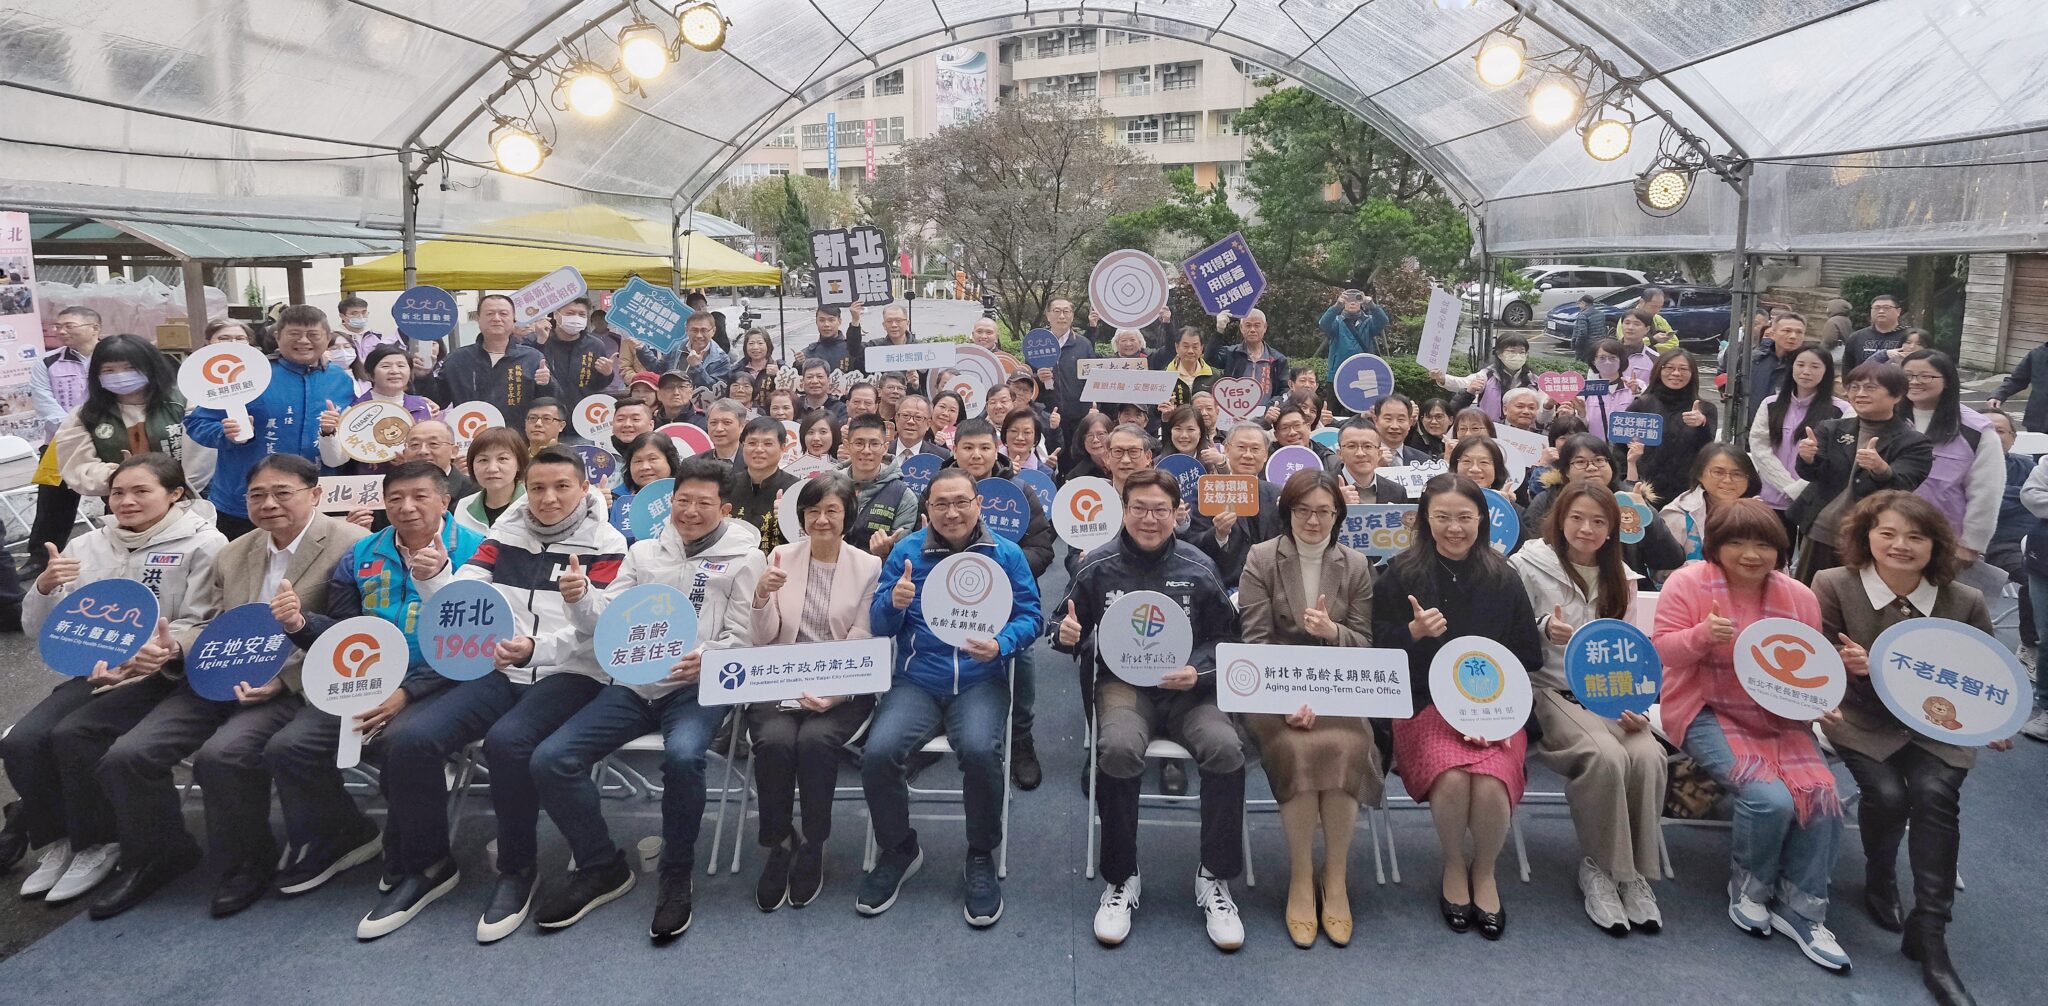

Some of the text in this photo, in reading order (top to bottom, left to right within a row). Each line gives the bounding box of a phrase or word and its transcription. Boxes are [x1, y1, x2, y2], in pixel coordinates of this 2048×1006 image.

[812, 230, 884, 267] 新北
[1199, 248, 1238, 277] 找得到
[818, 267, 889, 305] 日照
[1215, 281, 1254, 309] 沒煩惱
[401, 312, 452, 322] 新北醫動養
[886, 351, 923, 363] 新北熊讚
[206, 380, 254, 398] 長期照顧
[1234, 398, 1250, 409] do
[1612, 415, 1659, 429] 友好新北
[1070, 522, 1108, 534] 長期照顧
[1339, 511, 1402, 532] 智友善
[151, 555, 179, 563] KMT
[704, 562, 725, 571] KMT
[439, 598, 495, 628] 新北
[951, 607, 979, 619] 新北市
[54, 620, 136, 646] 新北醫動養
[628, 621, 669, 642] 高齡
[931, 617, 995, 634] 高齡長期照顧處
[198, 634, 286, 659] 在地安養
[433, 632, 497, 660] 1966
[611, 641, 683, 666] 友善住宅
[1585, 638, 1638, 664] 新北
[196, 654, 277, 670] Aging in Place
[750, 656, 874, 677] 新北市政府衛生局
[1120, 651, 1176, 664] 新北市政府
[1264, 666, 1400, 684] 新北市高齡長期照顧處
[1584, 670, 1634, 698] 熊讚
[1890, 651, 2010, 706] 不老長智村
[328, 677, 383, 695] 長期照顧
[1265, 683, 1401, 695] Aging and Long-Term Care Office
[1459, 706, 1514, 716] 衛生福利部
